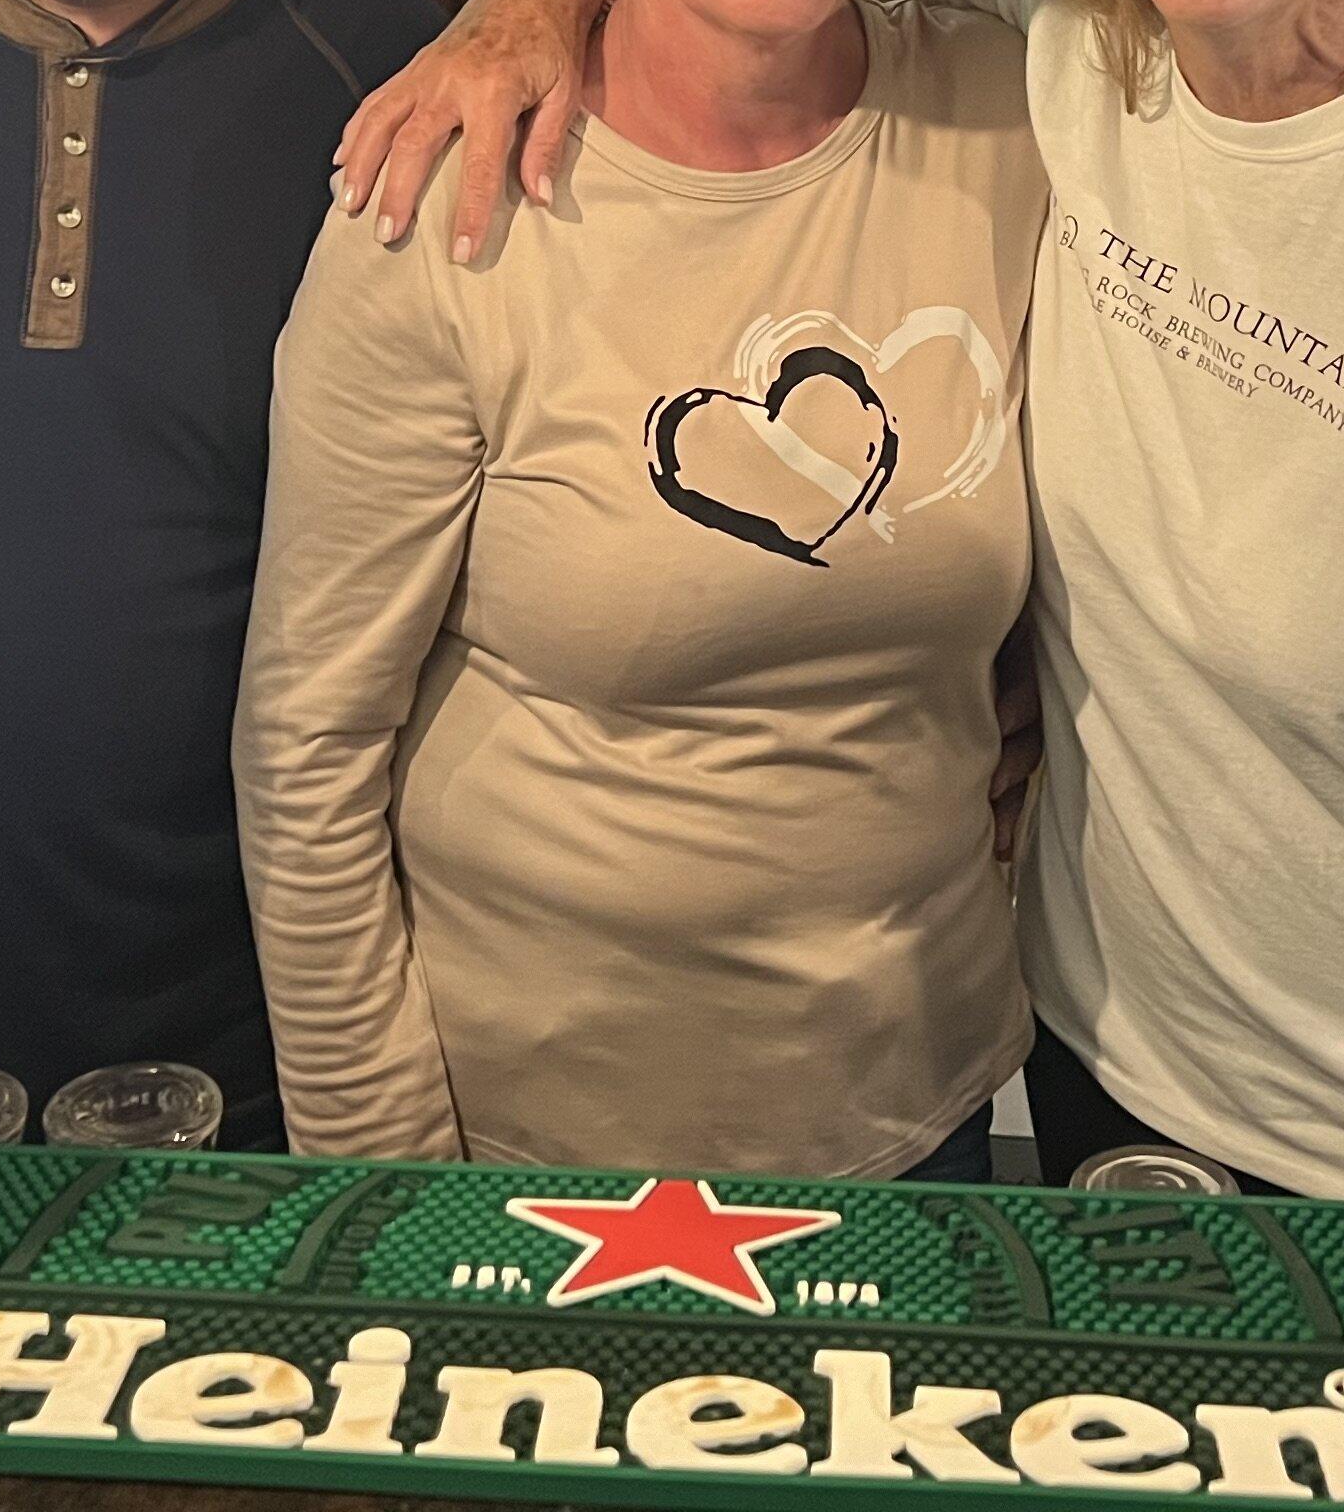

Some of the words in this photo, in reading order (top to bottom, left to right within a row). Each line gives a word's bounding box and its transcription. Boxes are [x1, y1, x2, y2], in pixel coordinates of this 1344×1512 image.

[1098, 227, 1180, 295] THE
[1096, 275, 1158, 322] ROCK
[1164, 313, 1246, 370] BREWING
[1111, 306, 1171, 352] HOUSE
[1194, 352, 1260, 399] BREWERY
